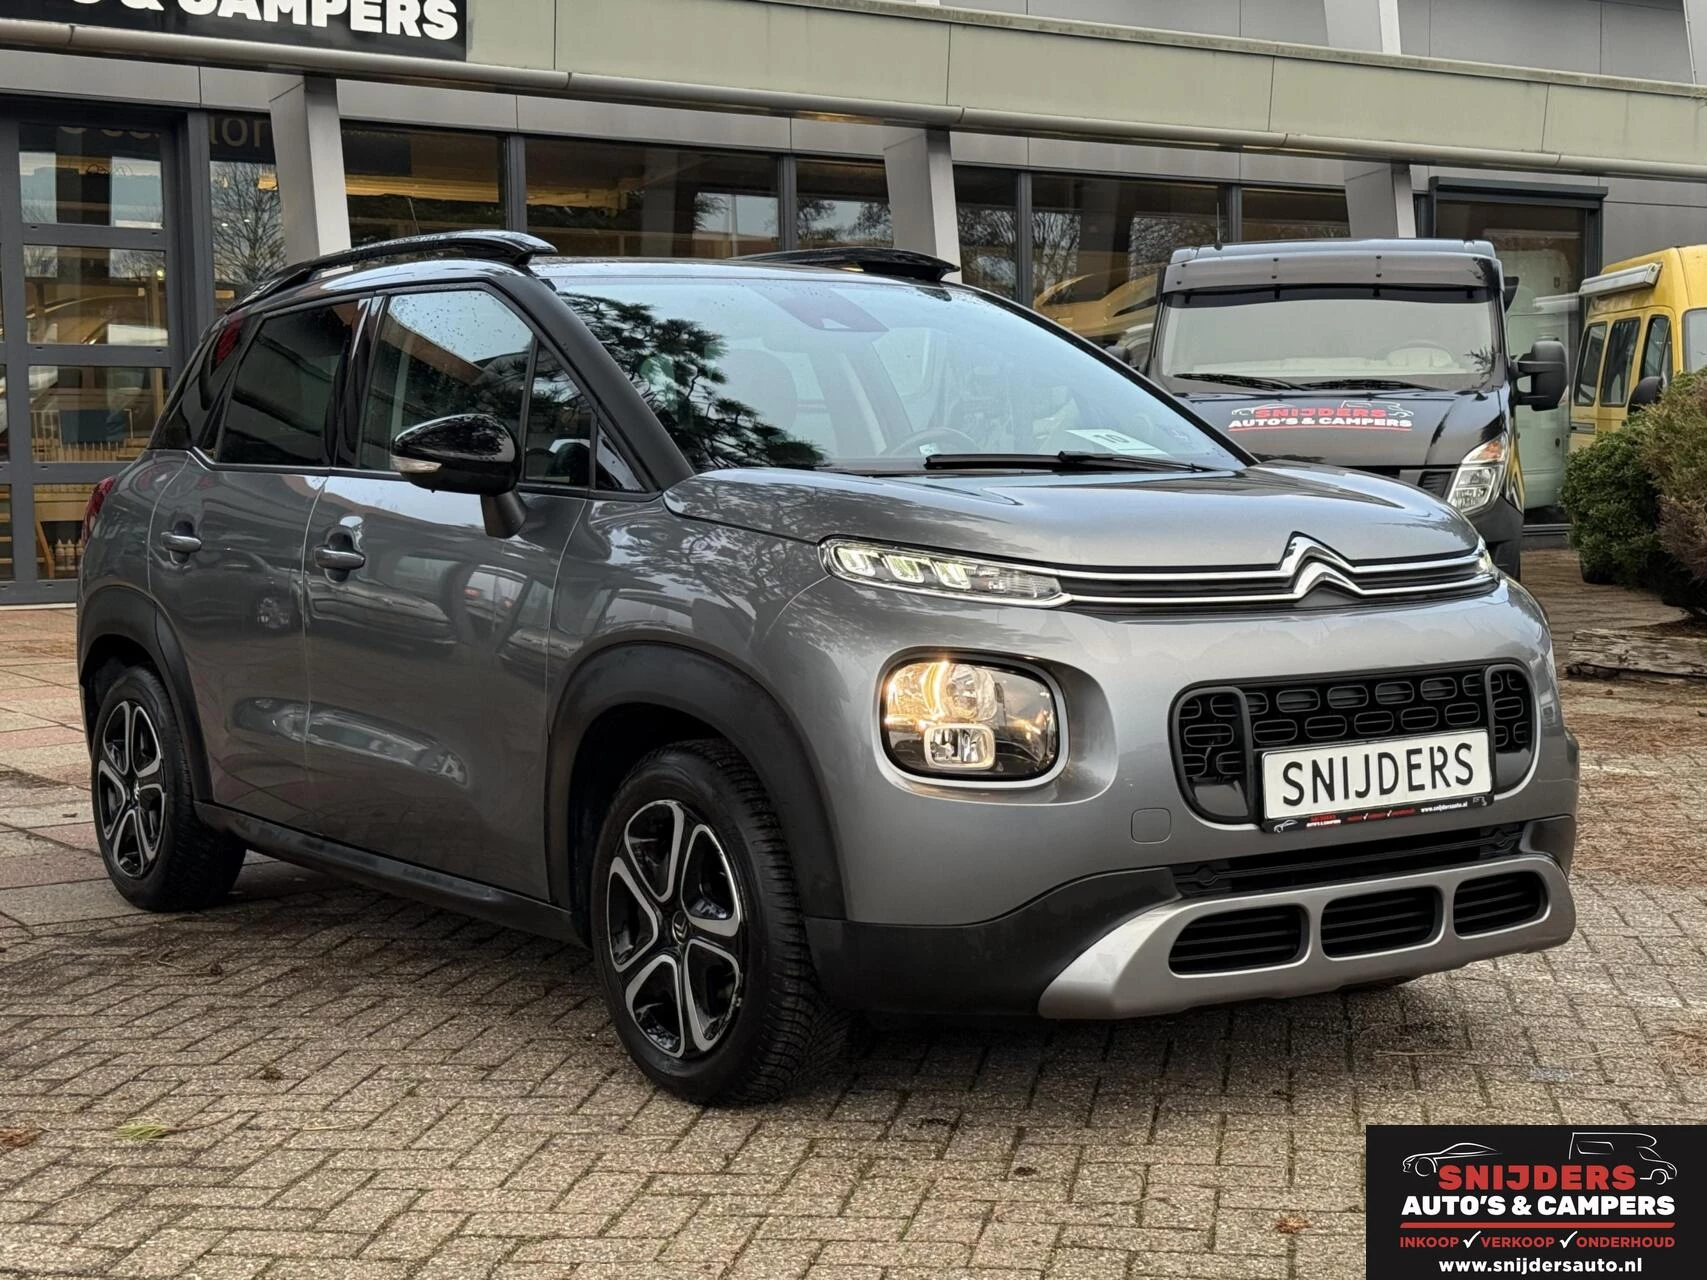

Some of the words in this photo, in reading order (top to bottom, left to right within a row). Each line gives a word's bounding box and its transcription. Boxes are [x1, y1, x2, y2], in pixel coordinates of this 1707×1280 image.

[1255, 407, 1387, 418] SNIJDERS
[1228, 417, 1298, 428] AUTO'S
[1301, 417, 1316, 425] &
[1318, 417, 1412, 427] CAMPERS
[1282, 742, 1474, 807] SNIJDERS
